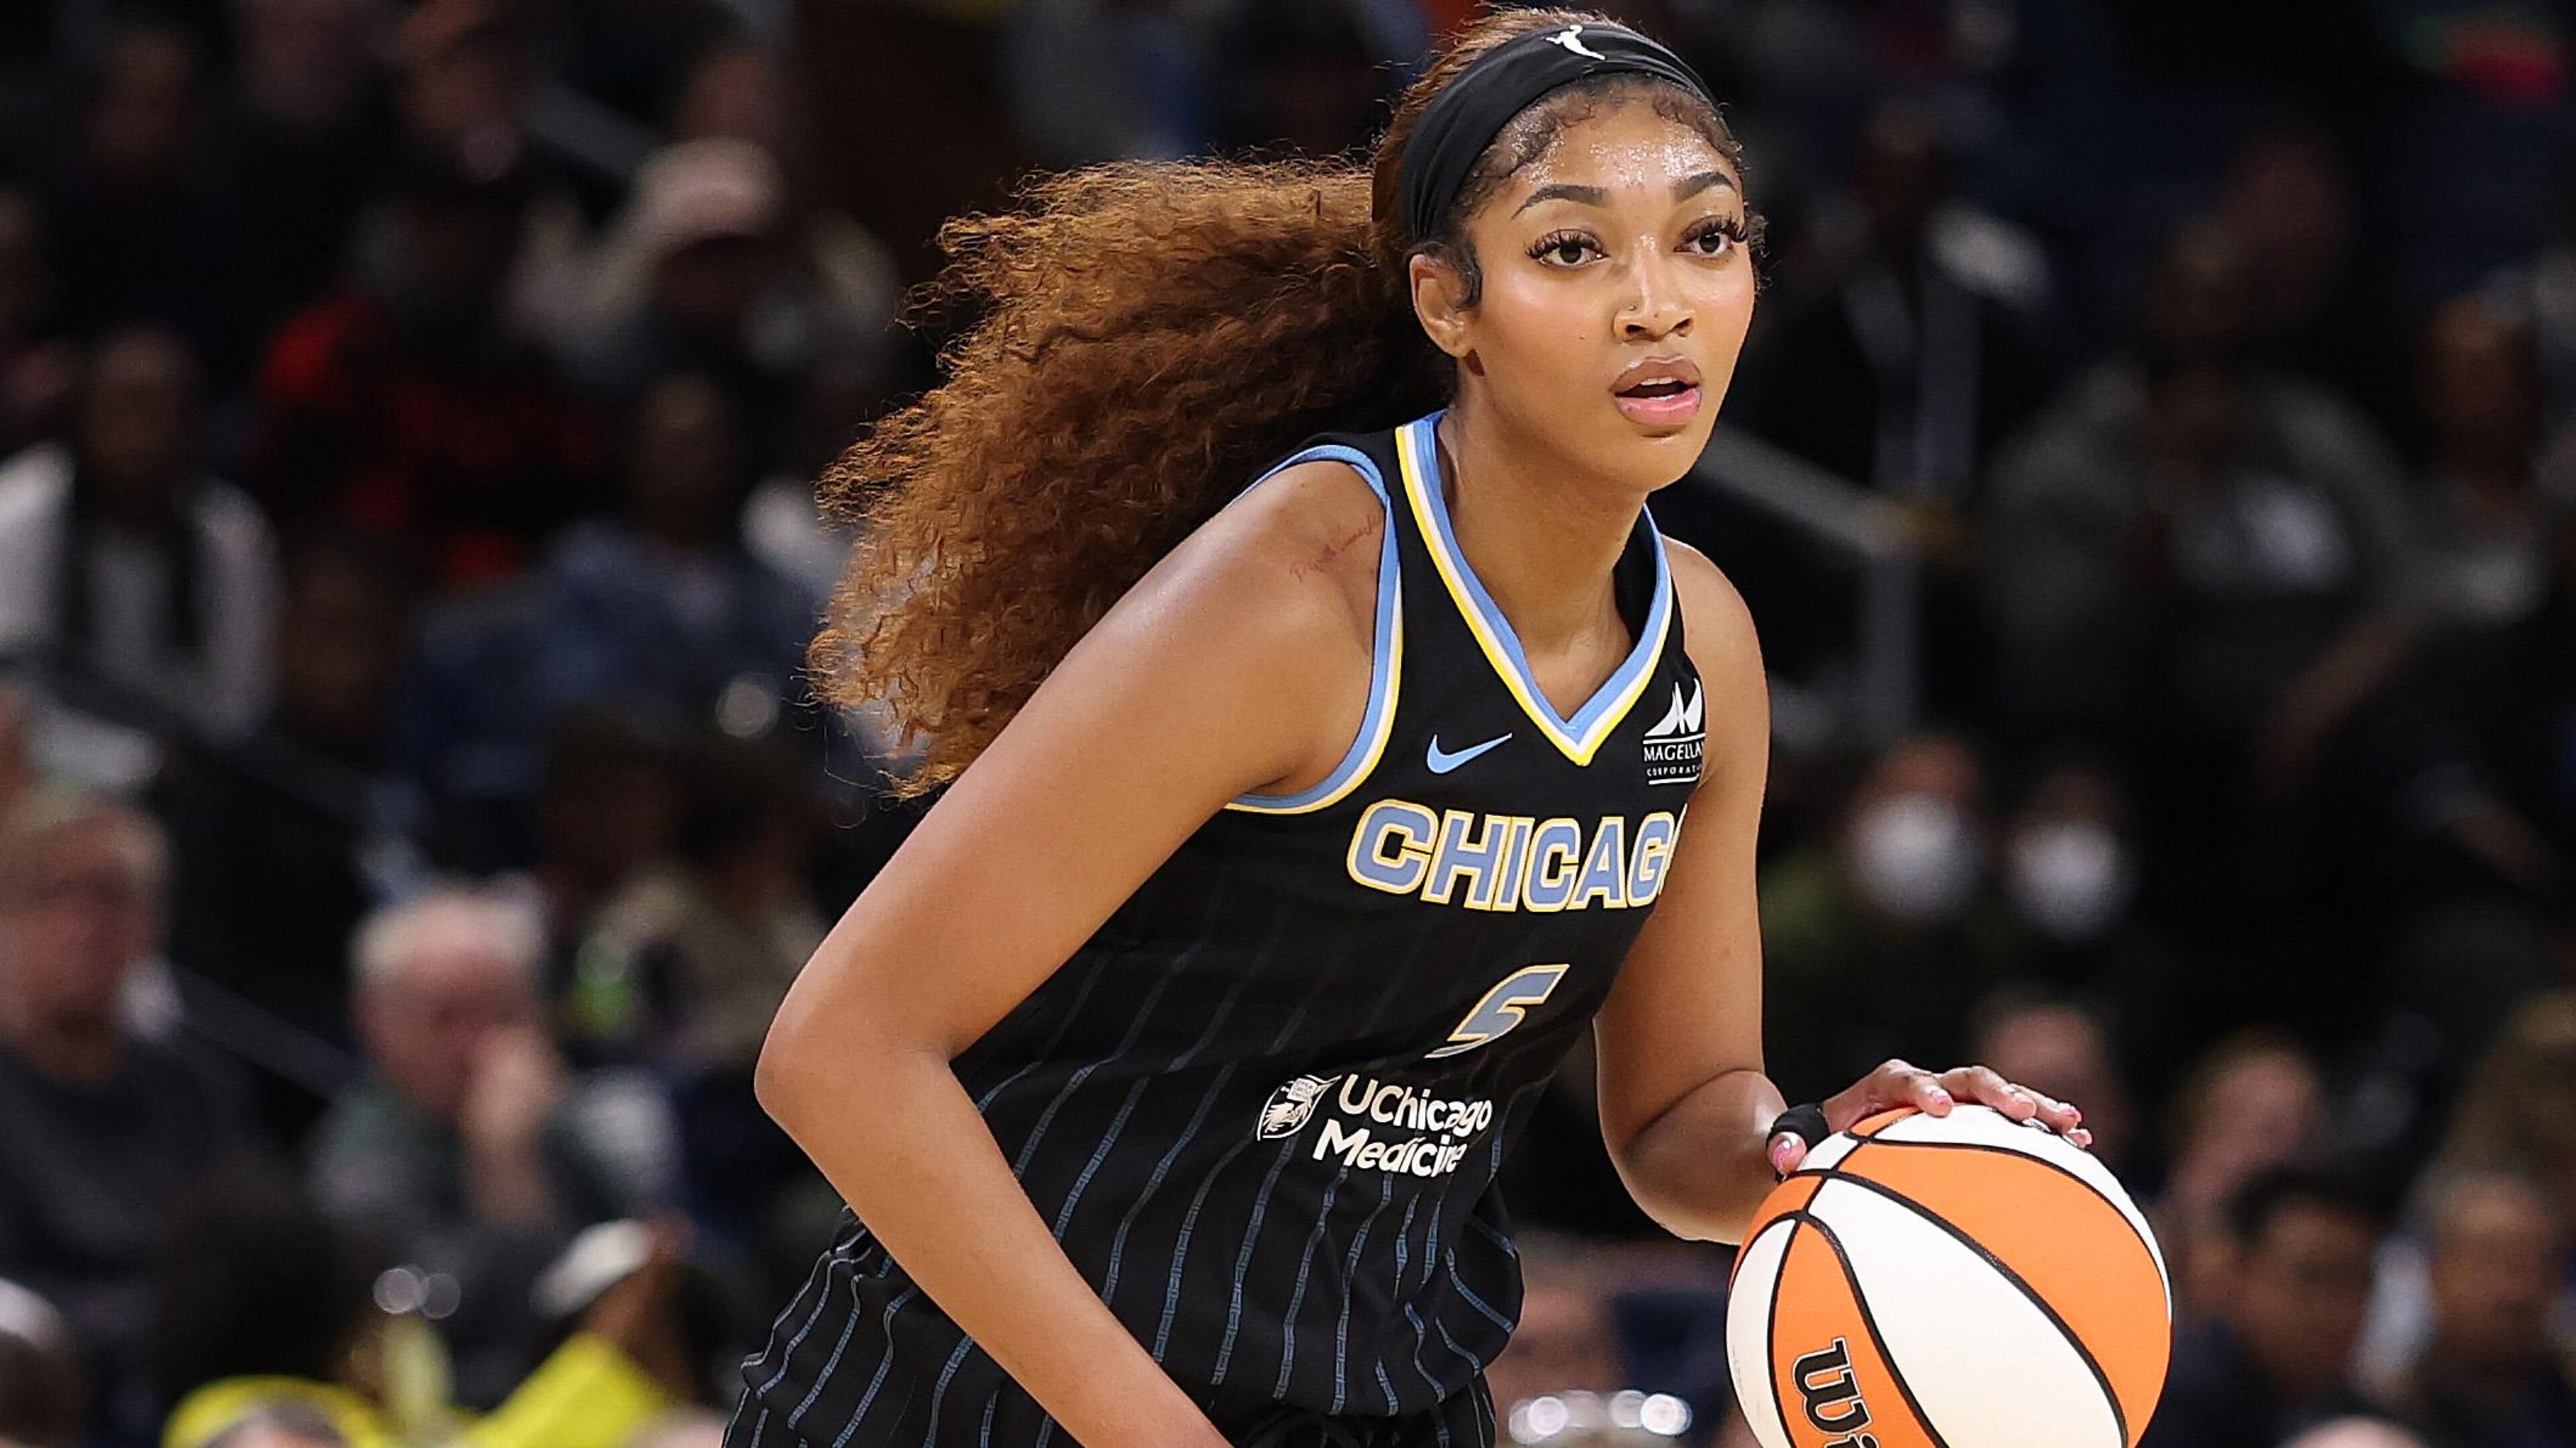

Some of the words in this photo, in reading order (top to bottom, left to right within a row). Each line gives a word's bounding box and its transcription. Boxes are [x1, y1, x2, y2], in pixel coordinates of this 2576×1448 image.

[1644, 741, 1703, 762] MAGELLA
[1646, 765, 1702, 776] CORPORAT
[1347, 799, 1688, 912] CHICAG
[1424, 963, 1570, 1058] 5
[1339, 1074, 1492, 1137] UChicago
